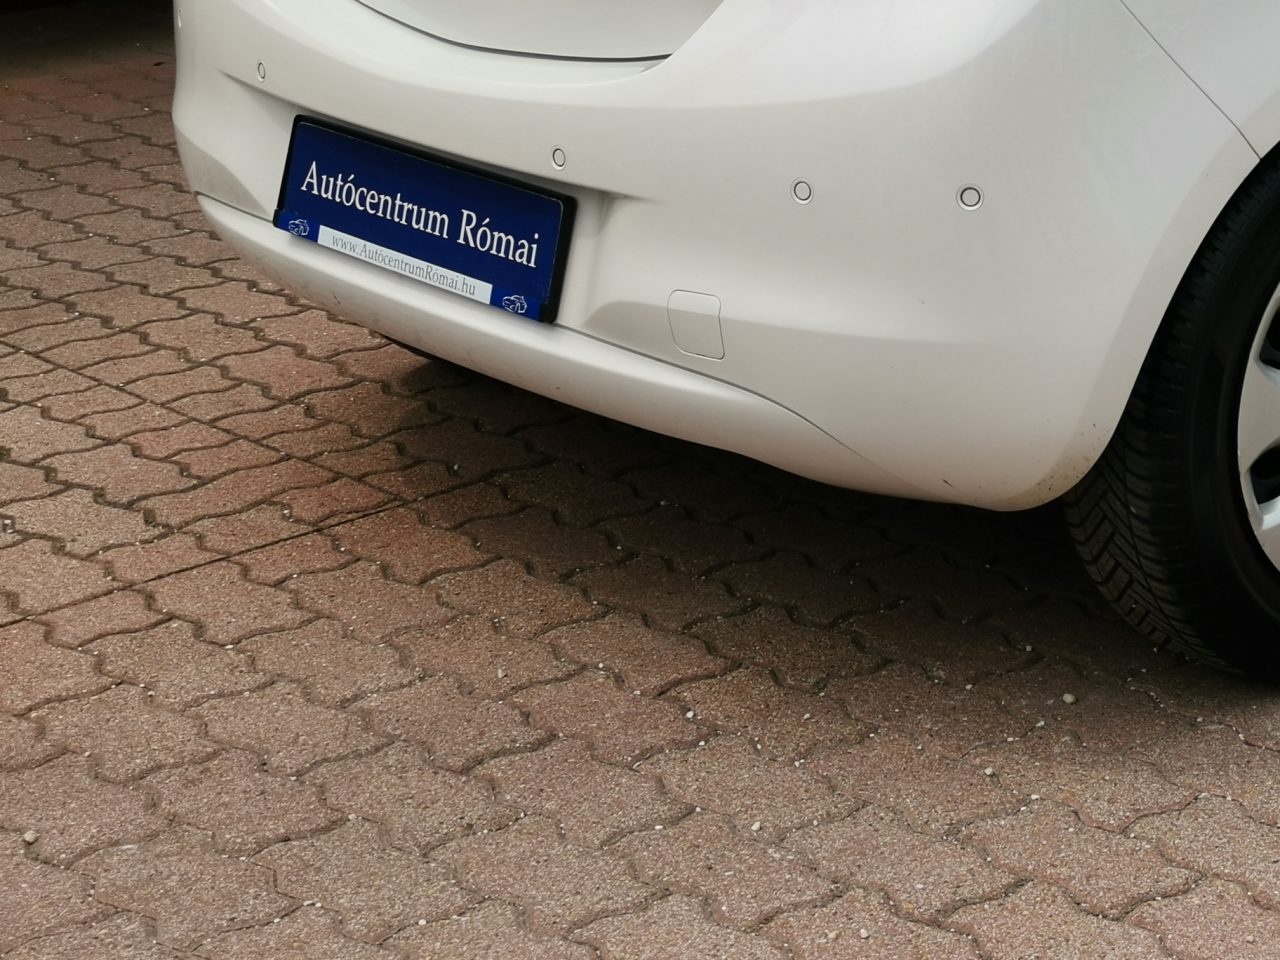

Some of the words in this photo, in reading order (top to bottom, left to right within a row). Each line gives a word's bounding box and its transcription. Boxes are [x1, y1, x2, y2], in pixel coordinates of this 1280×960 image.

[301, 160, 449, 239] Autócentrum
[456, 208, 540, 268] Római
[331, 234, 476, 297] www.AutócentrumRómai.hu
